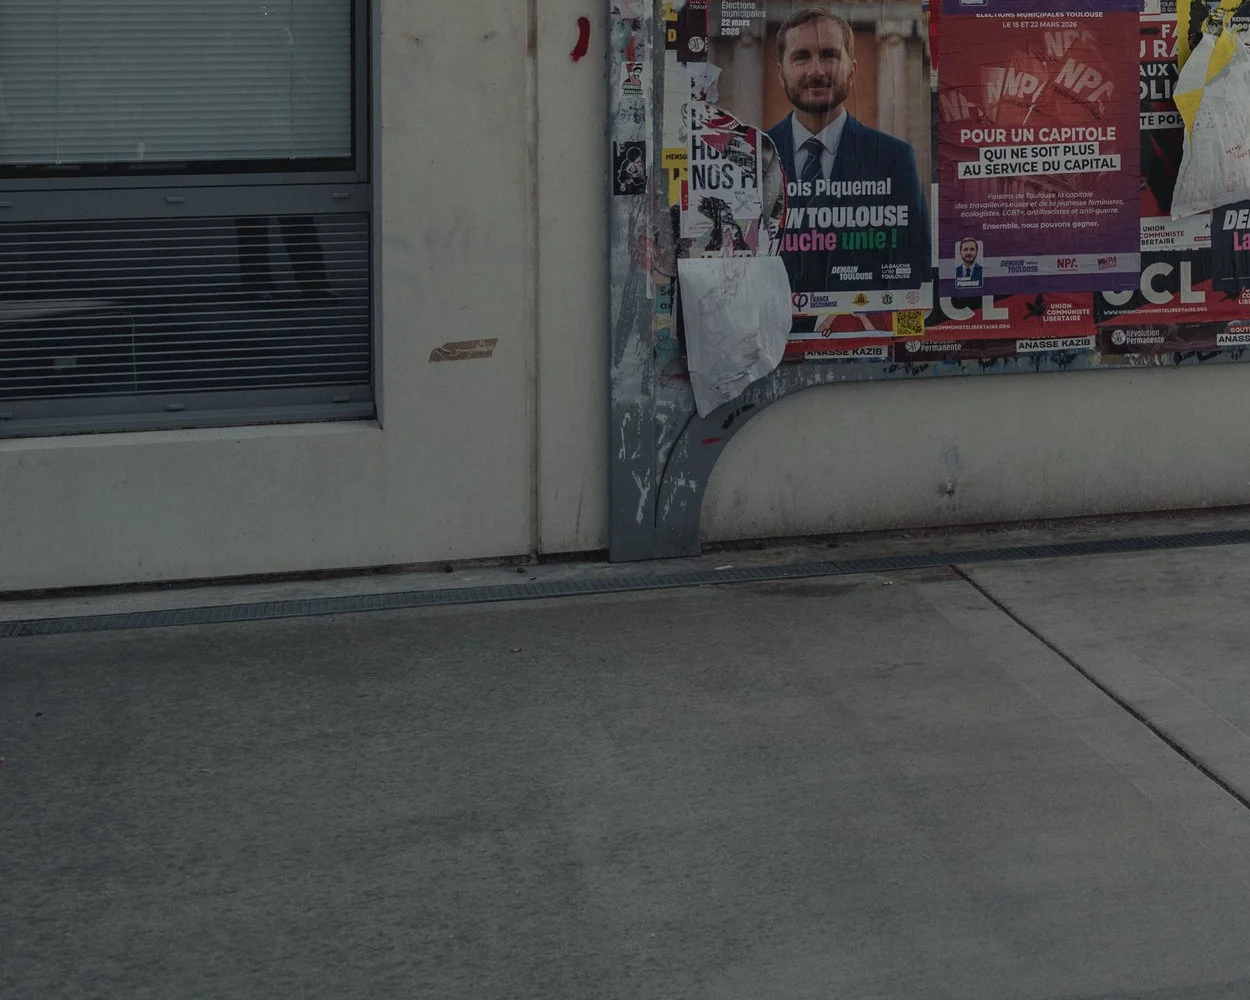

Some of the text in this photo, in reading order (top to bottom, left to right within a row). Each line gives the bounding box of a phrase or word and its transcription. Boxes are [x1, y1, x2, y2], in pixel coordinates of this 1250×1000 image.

[721, 0, 756, 9] Élections
[721, 9, 766, 18] municipales
[721, 19, 750, 27] 22 mars
[960, 126, 1117, 143] POUR UN CAPITOLE
[984, 144, 1095, 161] QUI NE SOIT PLUS
[963, 158, 1117, 176] AU SERVICE DU CAPITAL
[693, 163, 734, 190] NOS
[815, 178, 891, 198] Piquemal
[1065, 191, 1093, 199] capitale
[1057, 199, 1087, 208] jeunesse
[807, 205, 908, 228] TOULOUSE
[982, 222, 1020, 230] Ensemble,
[1040, 222, 1071, 230] pouvons
[1072, 221, 1099, 230] gagner.
[842, 228, 887, 249] unie
[1233, 231, 1250, 251] La
[1057, 259, 1078, 268] NPA
[832, 266, 858, 274] DEMAIN
[1008, 265, 1038, 273] TOULOUSE
[840, 272, 873, 280] TOULOUSE
[1126, 328, 1160, 337] Révolution
[1018, 338, 1091, 350] ANASSE KAZIB
[1126, 335, 1165, 345] Permanente
[852, 347, 883, 356] KAZIB
[921, 343, 962, 352] Permanente
